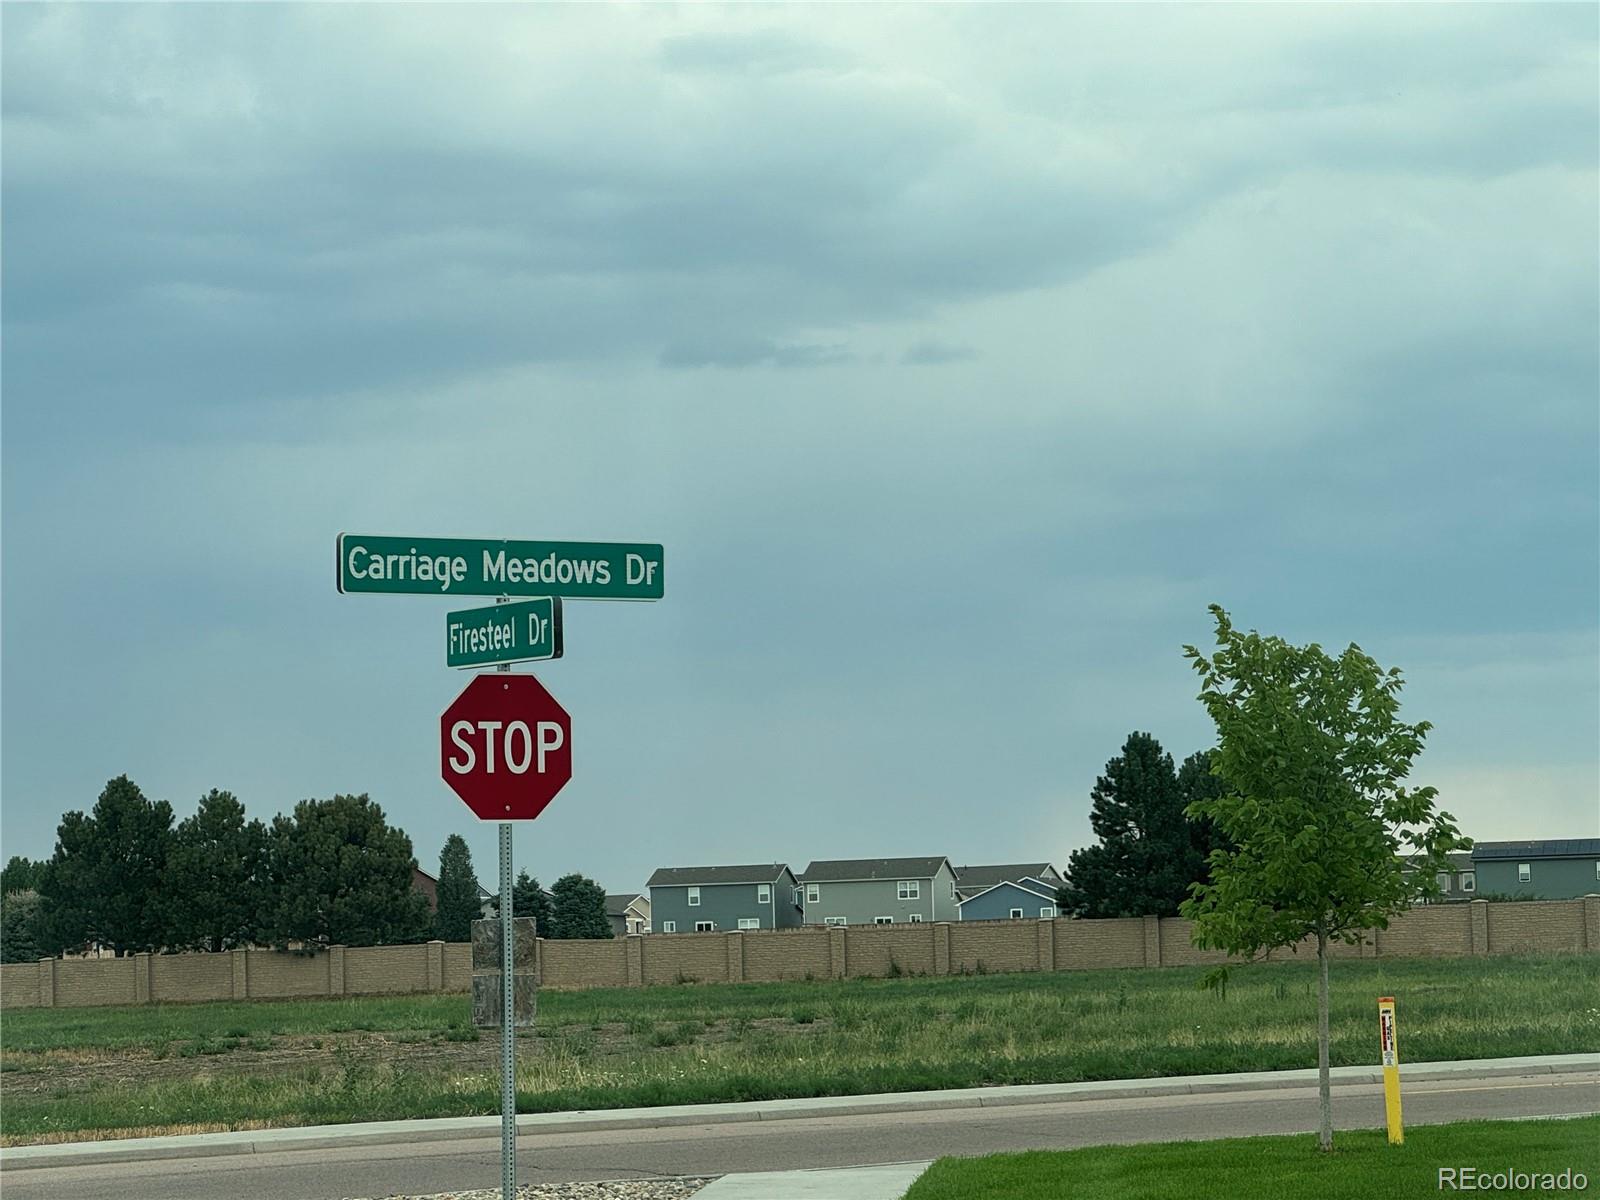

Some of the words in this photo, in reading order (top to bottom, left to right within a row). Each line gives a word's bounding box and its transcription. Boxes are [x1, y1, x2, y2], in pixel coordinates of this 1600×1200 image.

[349, 546, 467, 591] Carriage
[483, 550, 611, 584] Meadows
[626, 554, 658, 585] Dr
[450, 616, 515, 655] Firesteel
[528, 613, 548, 645] Dr
[450, 720, 564, 774] STOP
